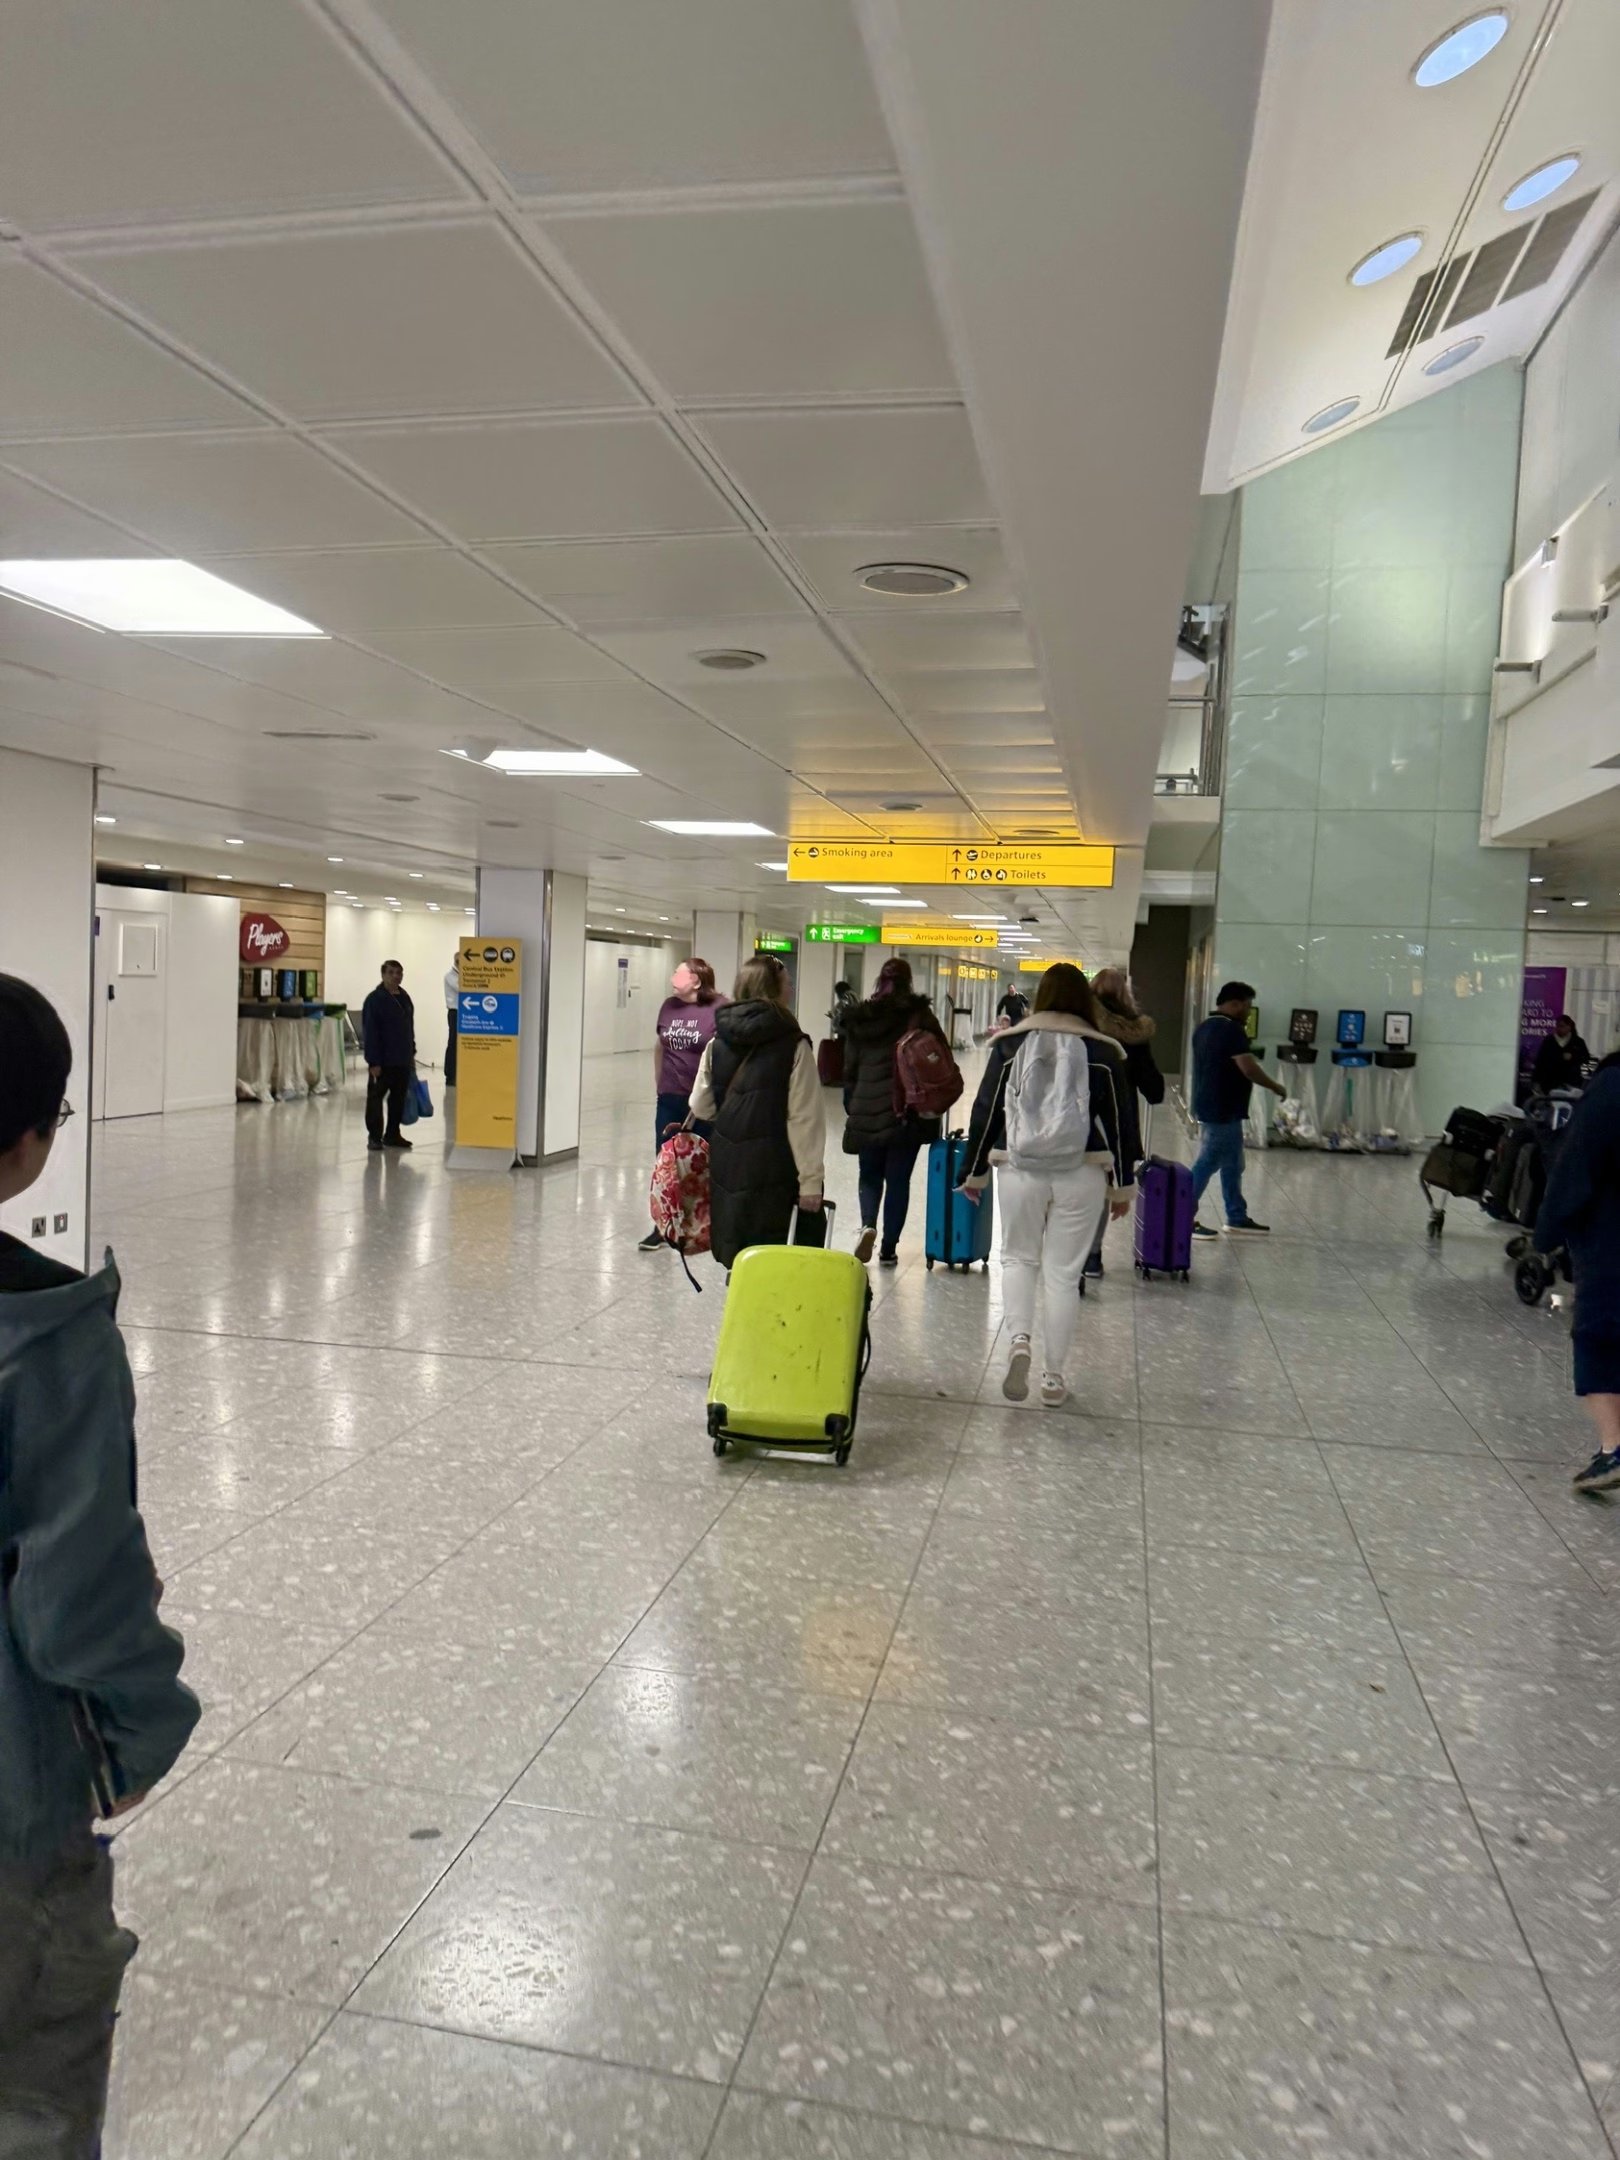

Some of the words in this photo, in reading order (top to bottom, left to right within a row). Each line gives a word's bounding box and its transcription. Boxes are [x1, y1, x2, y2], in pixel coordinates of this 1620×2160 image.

[822, 847, 867, 859] Smoking
[869, 849, 893, 858] area
[980, 850, 1042, 861] Departures
[1010, 869, 1047, 880] Toilets
[246, 922, 284, 956] Players
[915, 930, 944, 941] Arrivals
[948, 932, 973, 944] lounge
